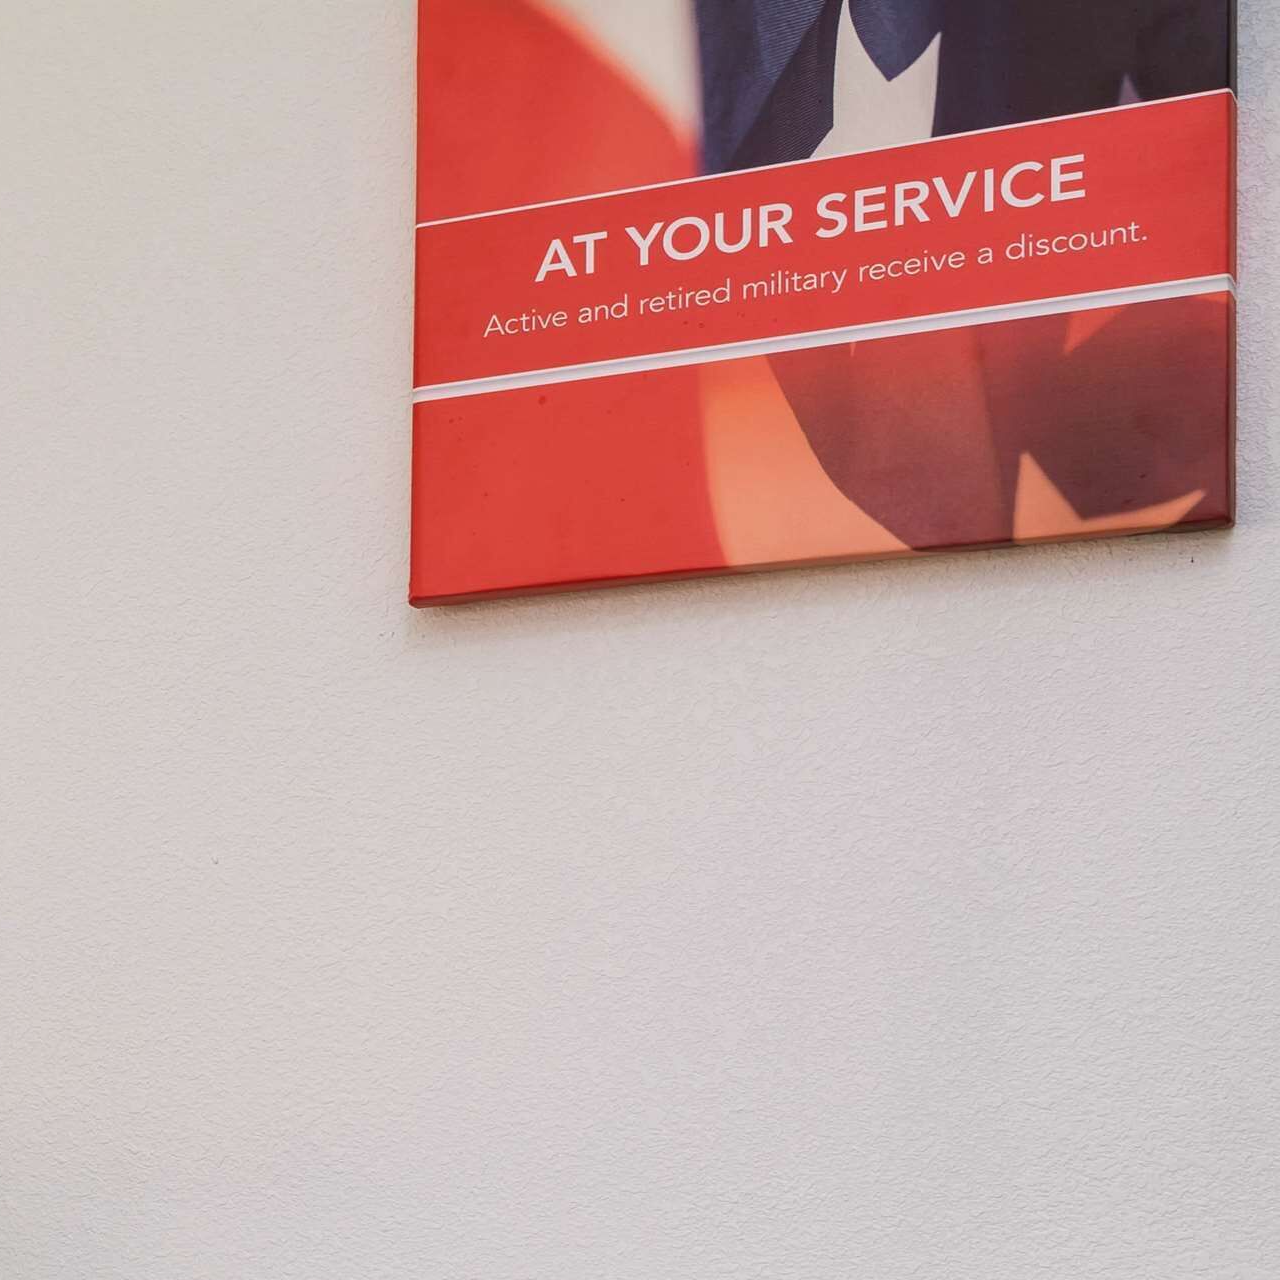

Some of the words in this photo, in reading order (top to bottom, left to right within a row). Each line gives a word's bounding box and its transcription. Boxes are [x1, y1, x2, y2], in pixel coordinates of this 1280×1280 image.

[534, 230, 608, 282] AT
[624, 202, 794, 266] YOUR
[815, 153, 1087, 240] SERVICE
[483, 308, 568, 338] Active
[577, 294, 629, 324] and
[639, 278, 732, 315] retired
[742, 268, 848, 299] military
[858, 249, 967, 283] receive
[976, 246, 994, 265] a
[1005, 221, 1148, 261] discount.
